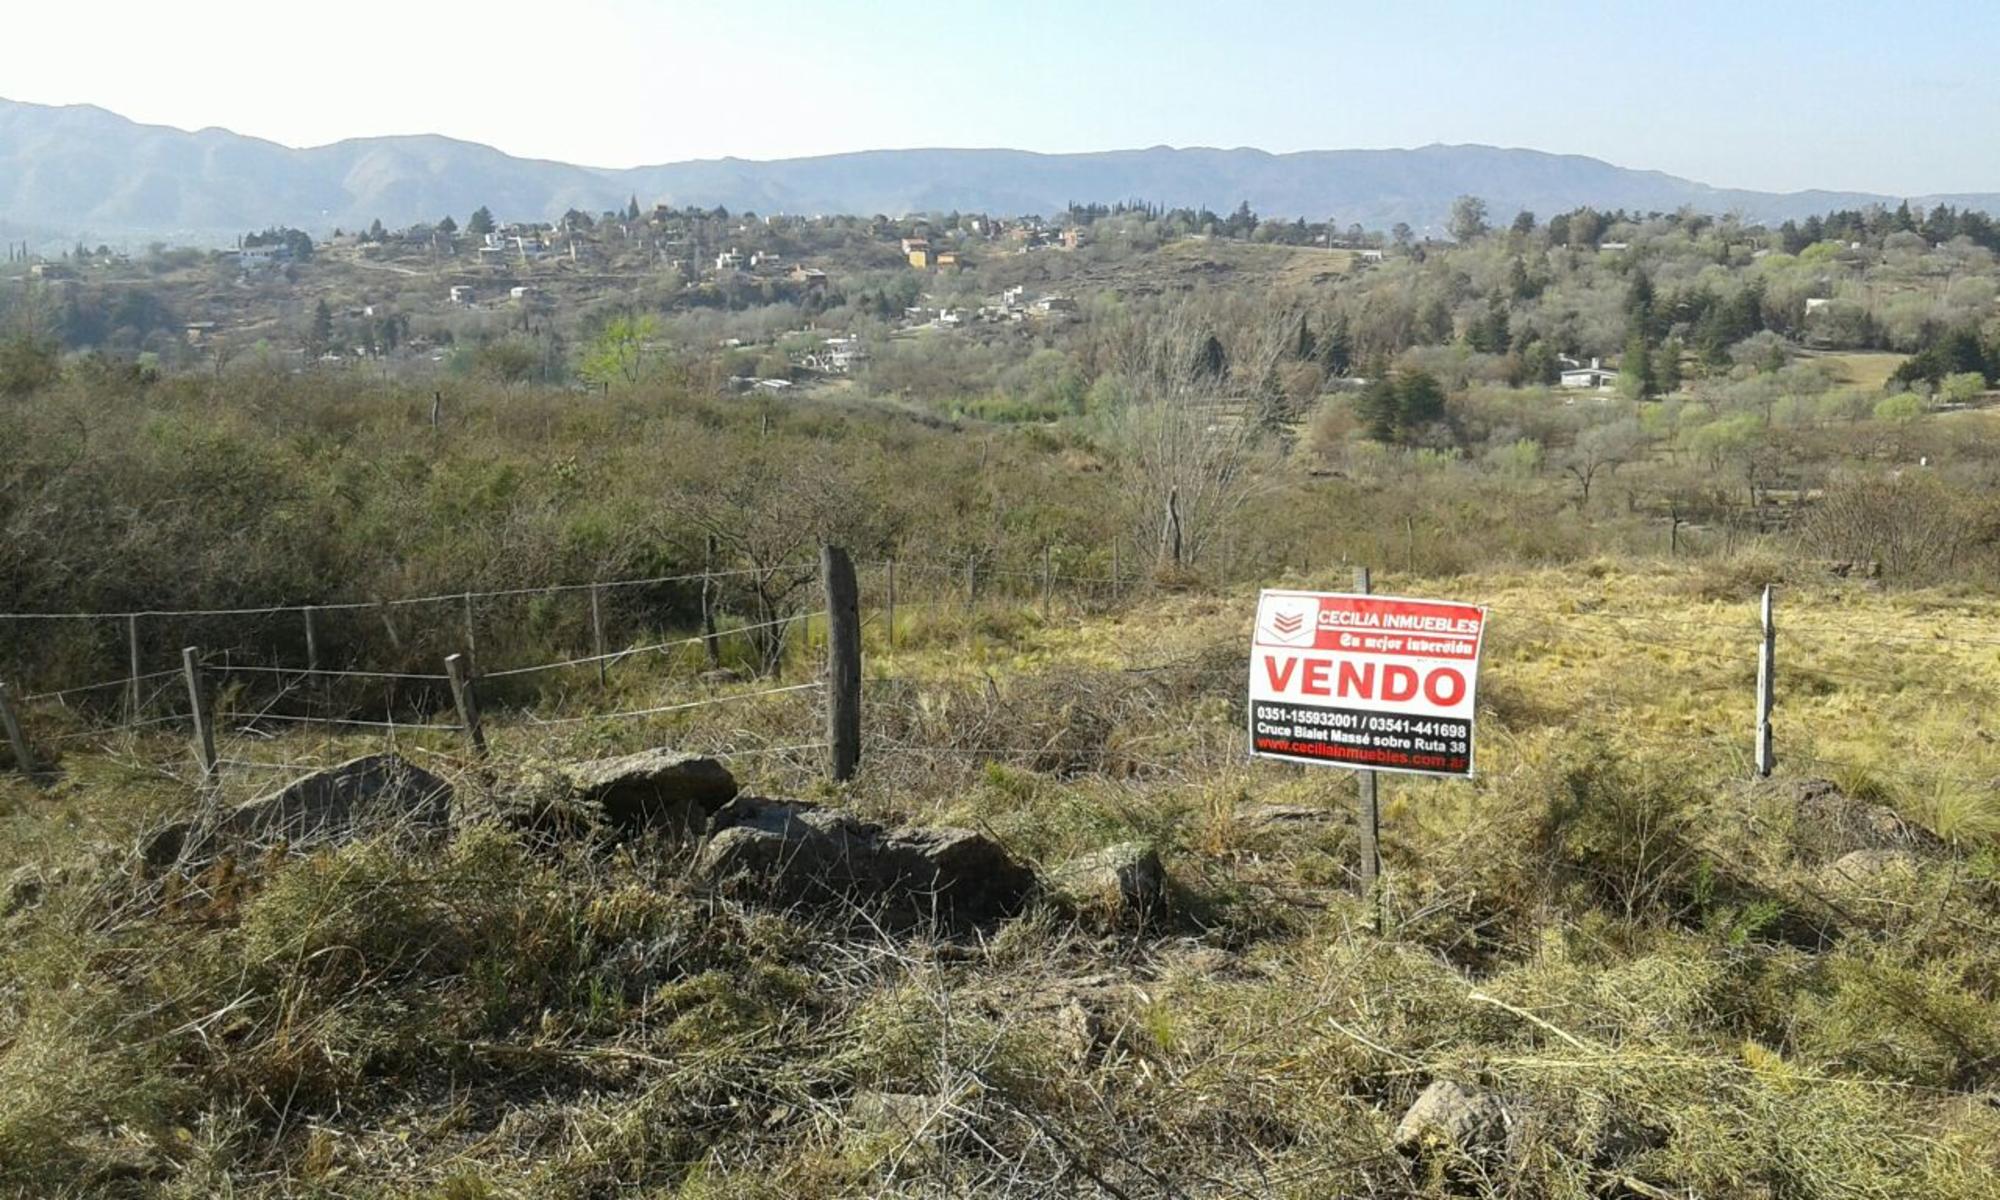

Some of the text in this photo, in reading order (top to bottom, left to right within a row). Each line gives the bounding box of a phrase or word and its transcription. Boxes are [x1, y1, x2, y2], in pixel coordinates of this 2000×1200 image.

[1318, 610, 1480, 634] CECILIA INMUEBLES
[1364, 636, 1403, 652] mejor
[1264, 655, 1467, 707] VENDO
[1257, 705, 1358, 729] 0351-155932001
[1369, 717, 1467, 739] 03541-441698
[1257, 722, 1467, 754] Cruce Bialet Massé sobre Ruta 38
[1257, 737, 1467, 769] www.ceciliainmuebles.com.ar
